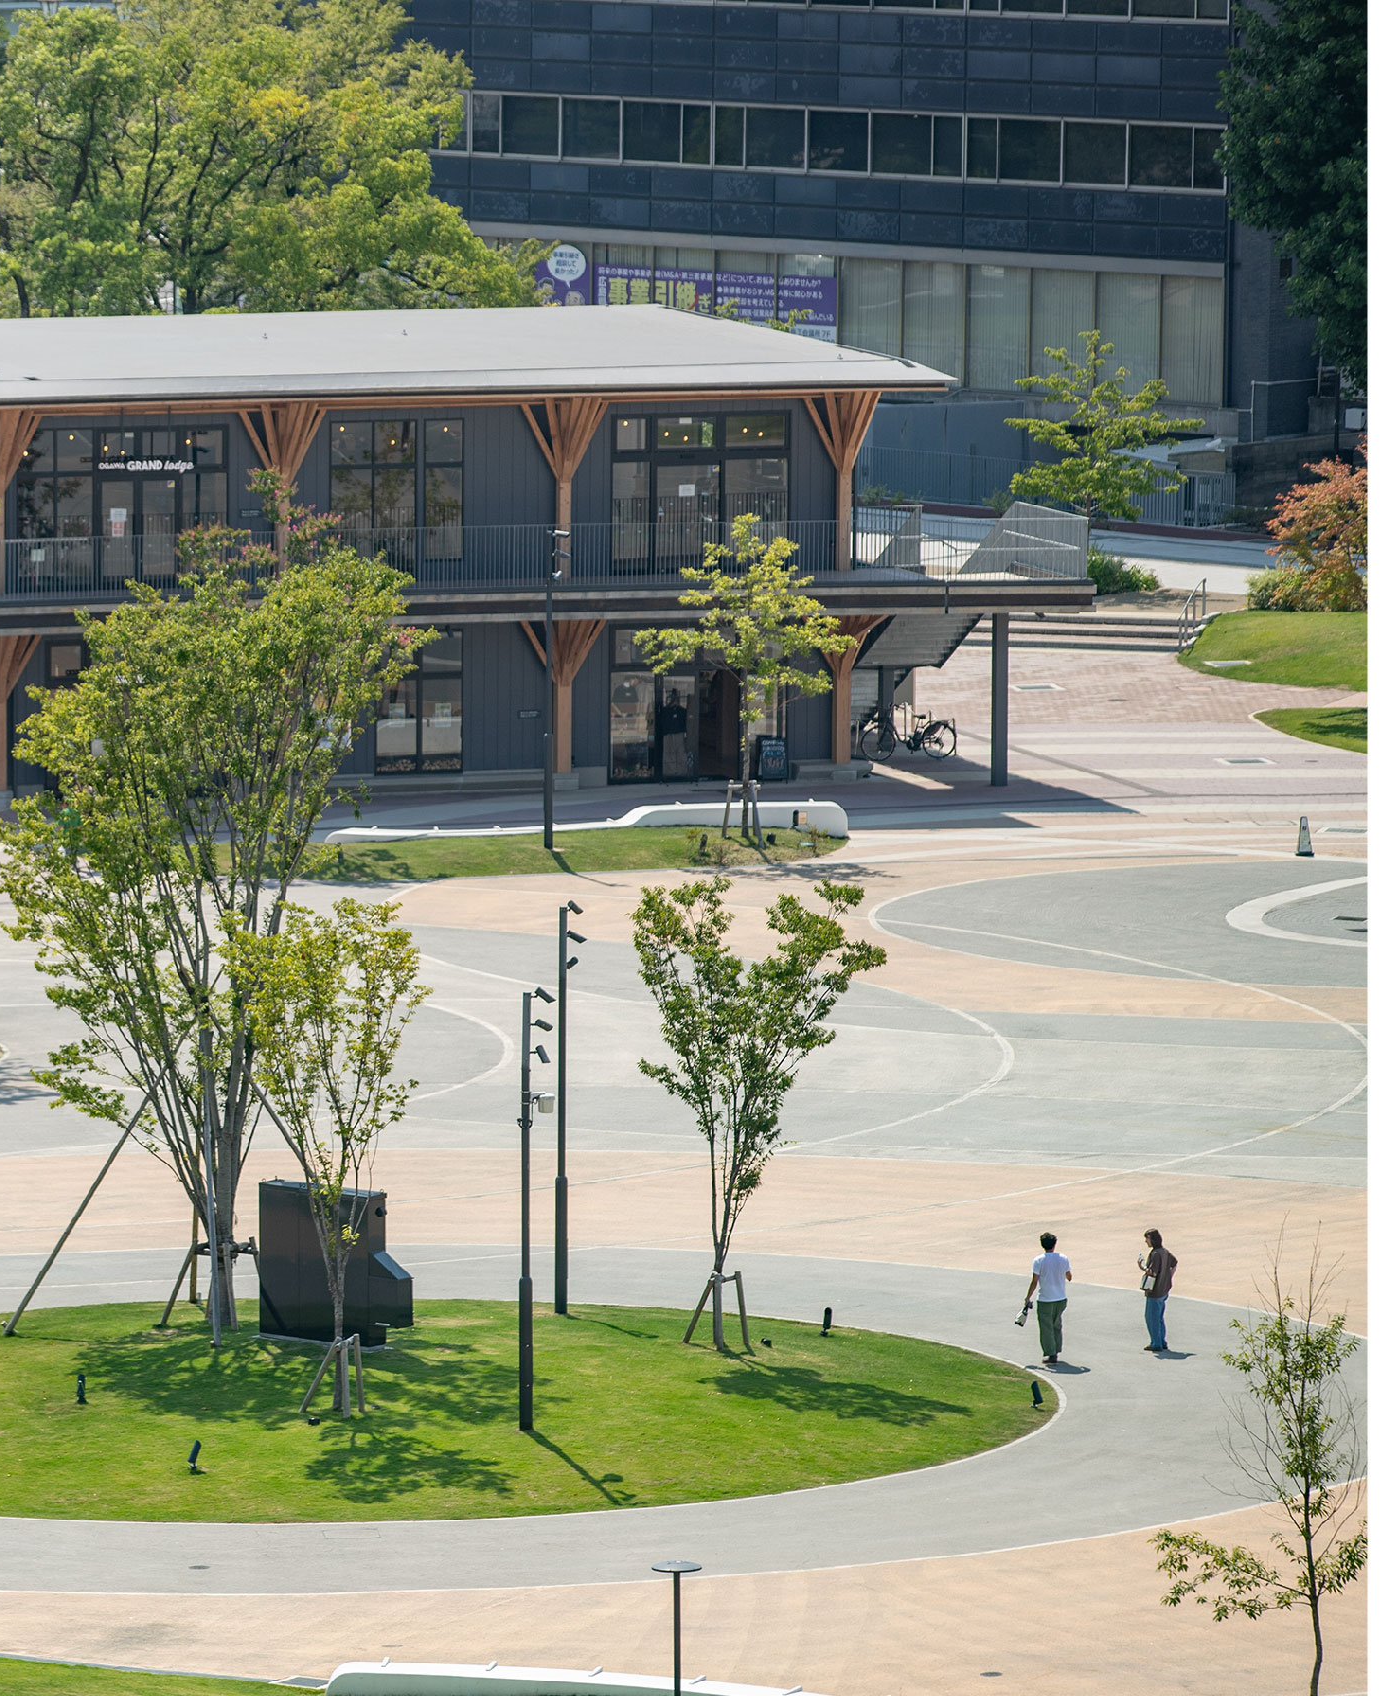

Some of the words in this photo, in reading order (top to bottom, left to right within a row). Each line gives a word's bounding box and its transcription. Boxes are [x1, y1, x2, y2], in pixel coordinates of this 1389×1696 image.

[98, 462, 125, 470] OGAWA
[126, 459, 163, 471] GRAND
[163, 460, 194, 473] lodge
